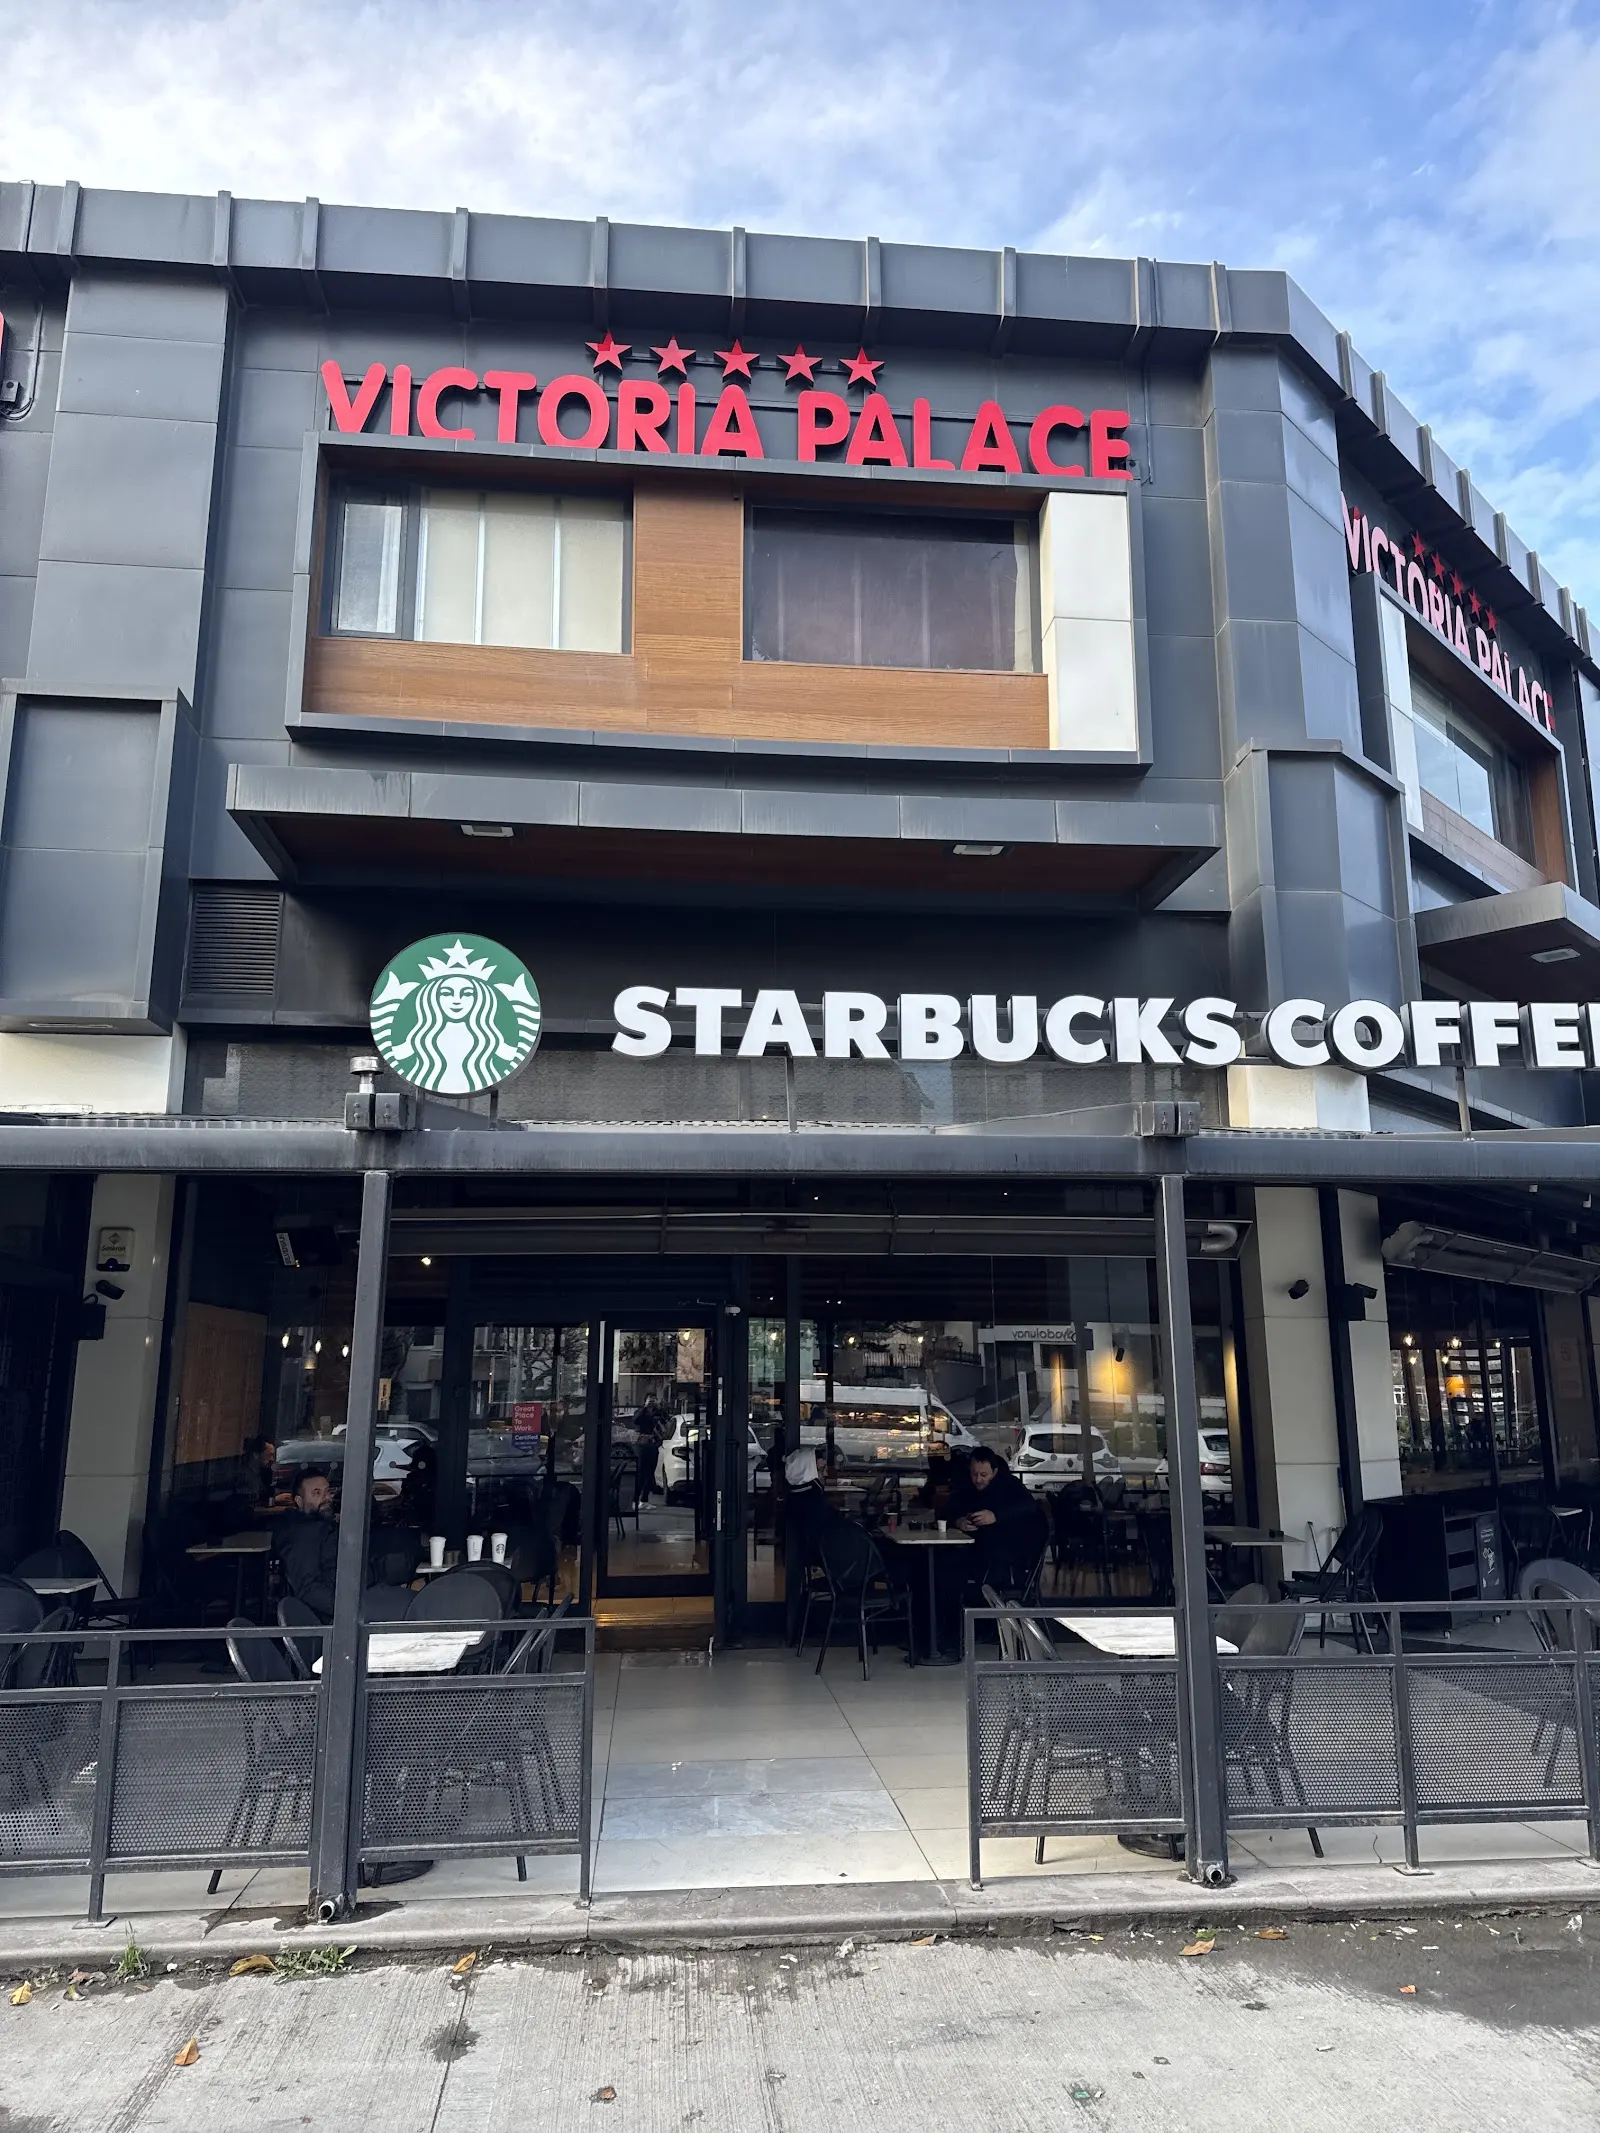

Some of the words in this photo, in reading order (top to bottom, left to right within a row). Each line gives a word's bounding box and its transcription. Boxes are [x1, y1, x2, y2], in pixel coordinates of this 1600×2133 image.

[321, 359, 765, 460] VICTORIA
[801, 389, 1134, 480] PALACE
[1340, 490, 1472, 661] VICTORIA
[611, 985, 1242, 1067] STARBUCKS
[1263, 997, 1600, 1069] COFFE
